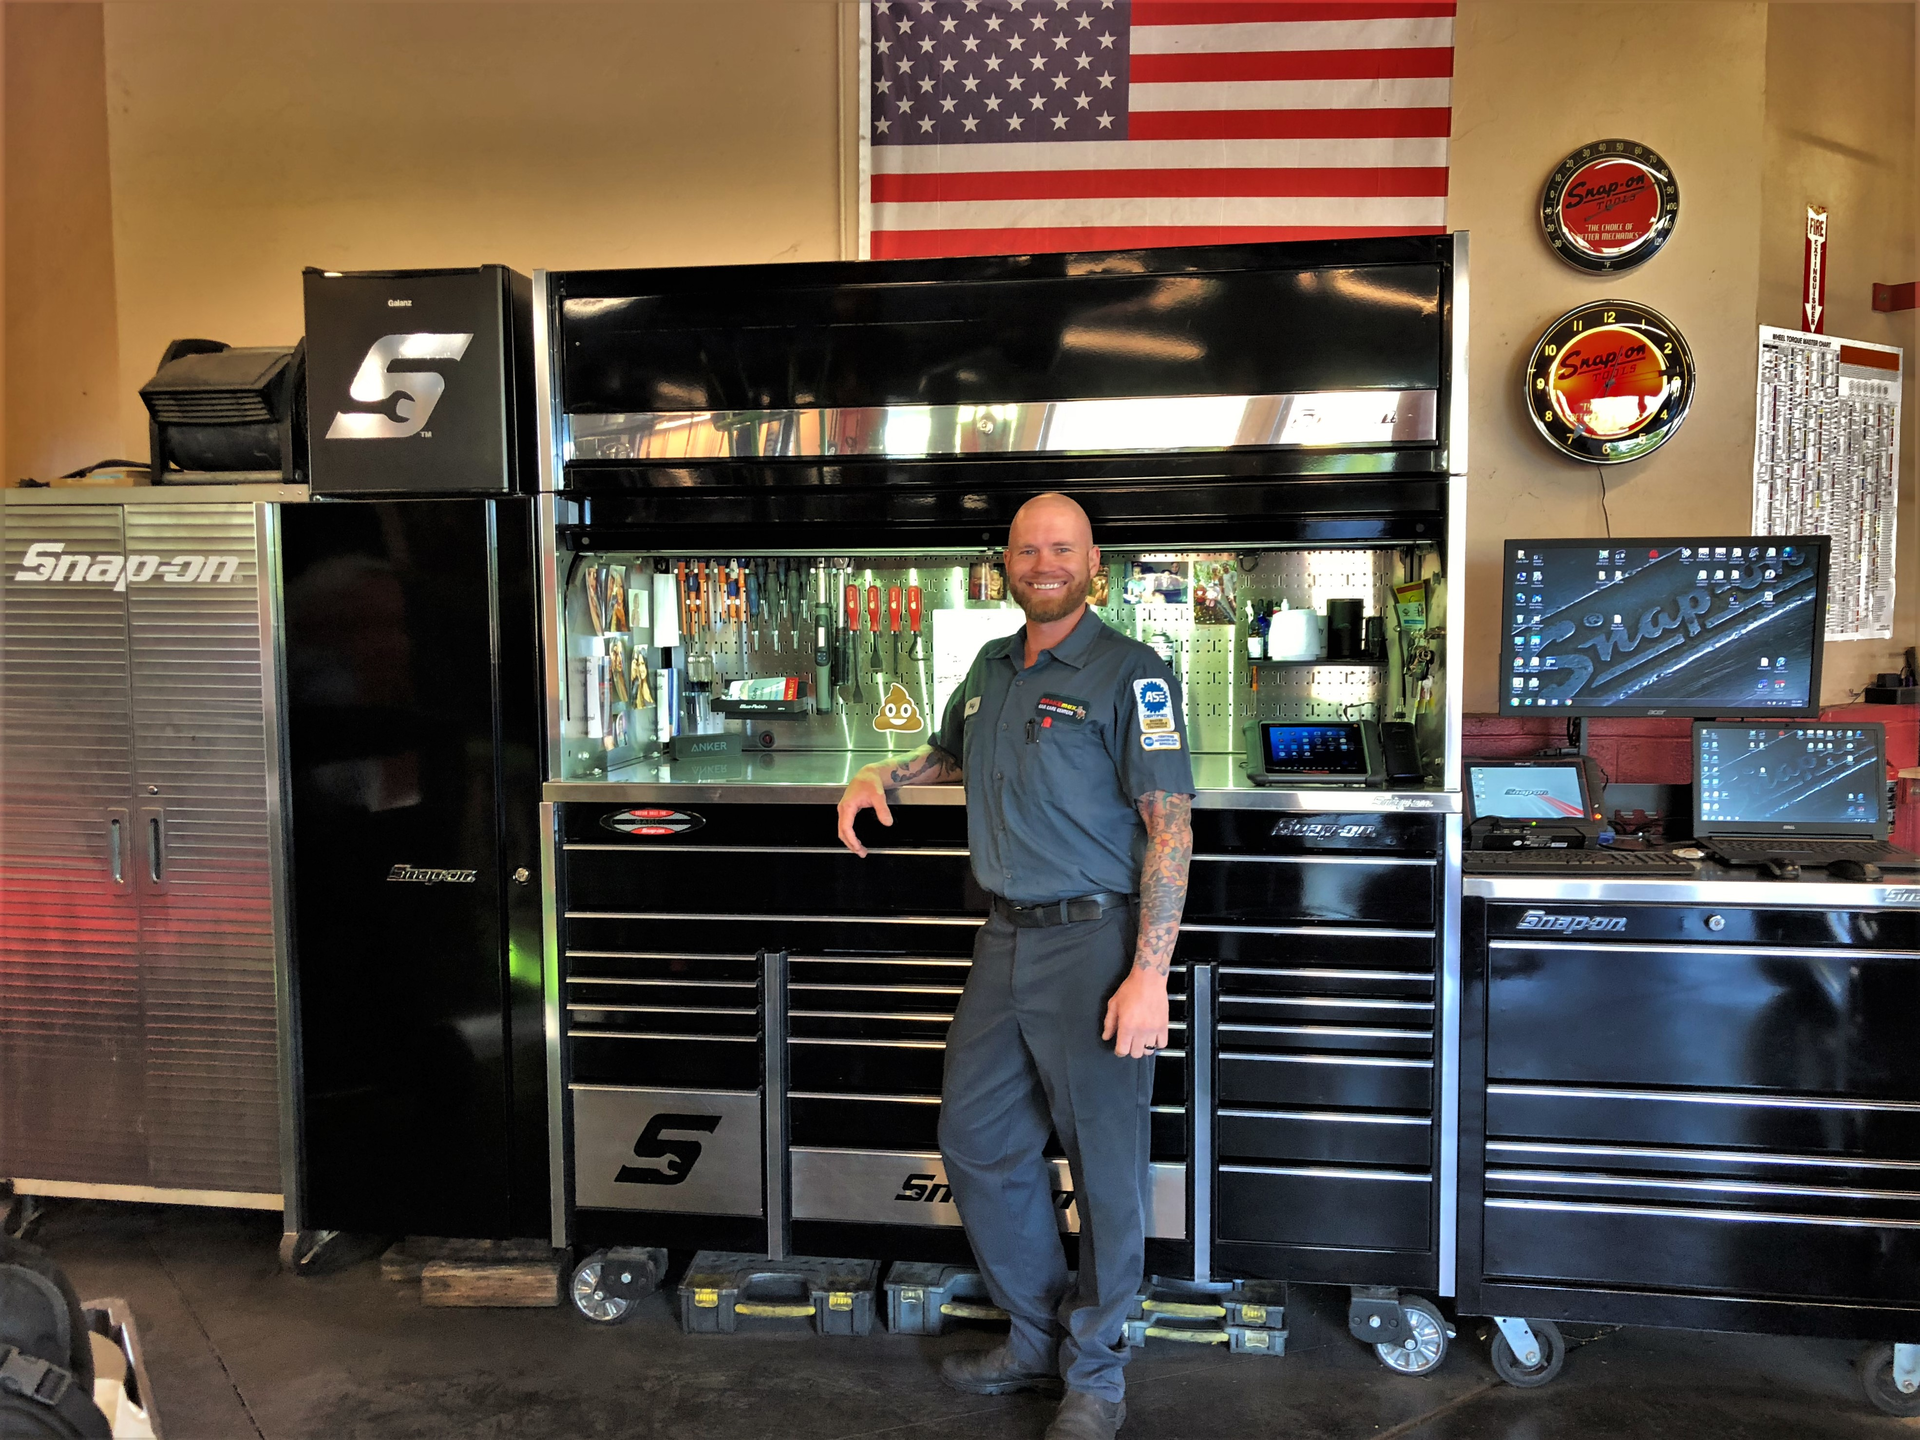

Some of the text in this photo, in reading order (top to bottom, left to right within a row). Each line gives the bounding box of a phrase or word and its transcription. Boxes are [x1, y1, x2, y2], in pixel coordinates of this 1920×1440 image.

[1583, 149, 1590, 157] 30
[1566, 160, 1574, 168] 20
[1650, 155, 1658, 163] 70
[1550, 190, 1554, 198] 0
[1566, 174, 1644, 209] Snap-on
[1667, 186, 1674, 194] 90
[1596, 194, 1636, 210] TOOLS
[1666, 202, 1677, 210] 100
[1601, 223, 1623, 231] CHOICE
[1810, 218, 1824, 237] FIRE
[1604, 312, 1616, 323] 12
[1574, 320, 1583, 331] 11
[1545, 345, 1557, 356] 10
[1664, 342, 1672, 354] 2
[1536, 378, 1545, 390] 9
[1545, 410, 1553, 421] 8
[1660, 409, 1668, 420] 4
[1566, 433, 1574, 444] 7
[1602, 444, 1610, 454] 6
[14, 543, 240, 591] Snap-on
[1145, 691, 1165, 702] ASE
[691, 742, 727, 752] ANKER
[1272, 818, 1376, 840] Snap-on
[386, 864, 477, 885] Snap-on
[1516, 910, 1627, 934] Snap-on
